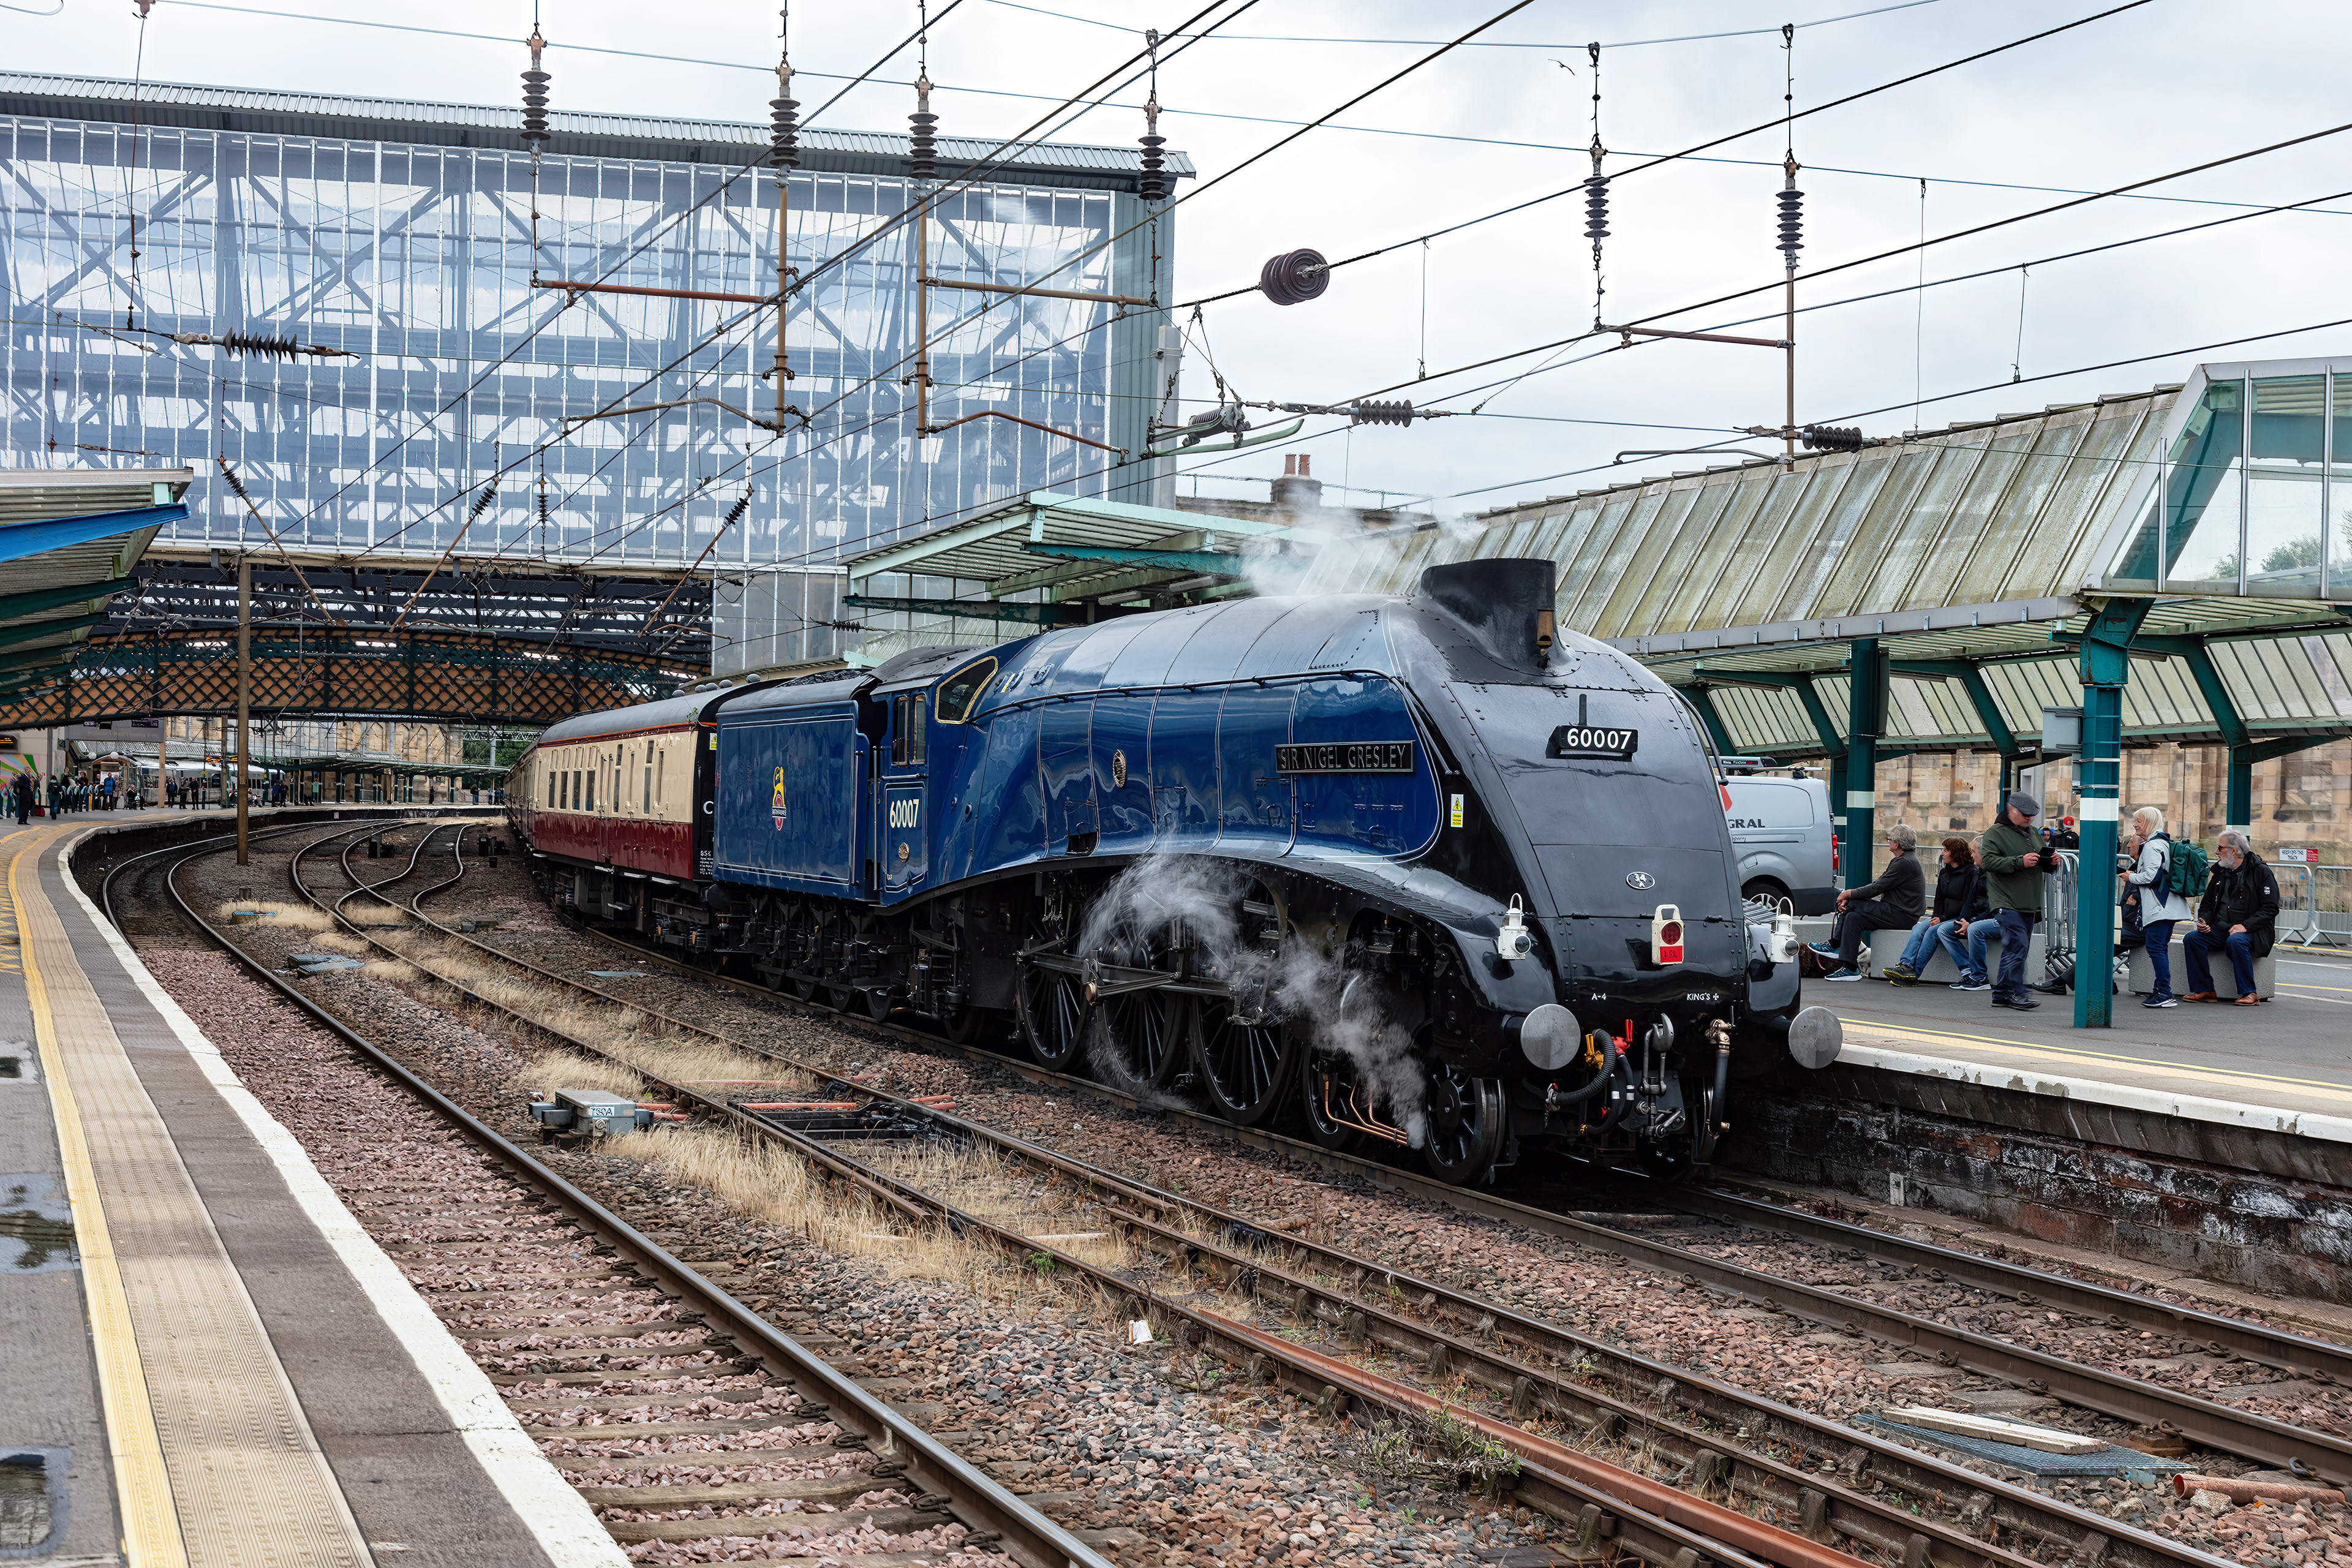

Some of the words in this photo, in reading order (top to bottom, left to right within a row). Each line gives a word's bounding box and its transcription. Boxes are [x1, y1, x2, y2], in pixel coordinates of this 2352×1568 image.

[1567, 728, 1632, 750] 60007
[1281, 748, 1299, 769] SIR
[1303, 746, 1341, 769] NIGEL
[1348, 745, 1406, 768] GRESLEY
[889, 799, 919, 829] 60007
[1634, 873, 1647, 883] 34
